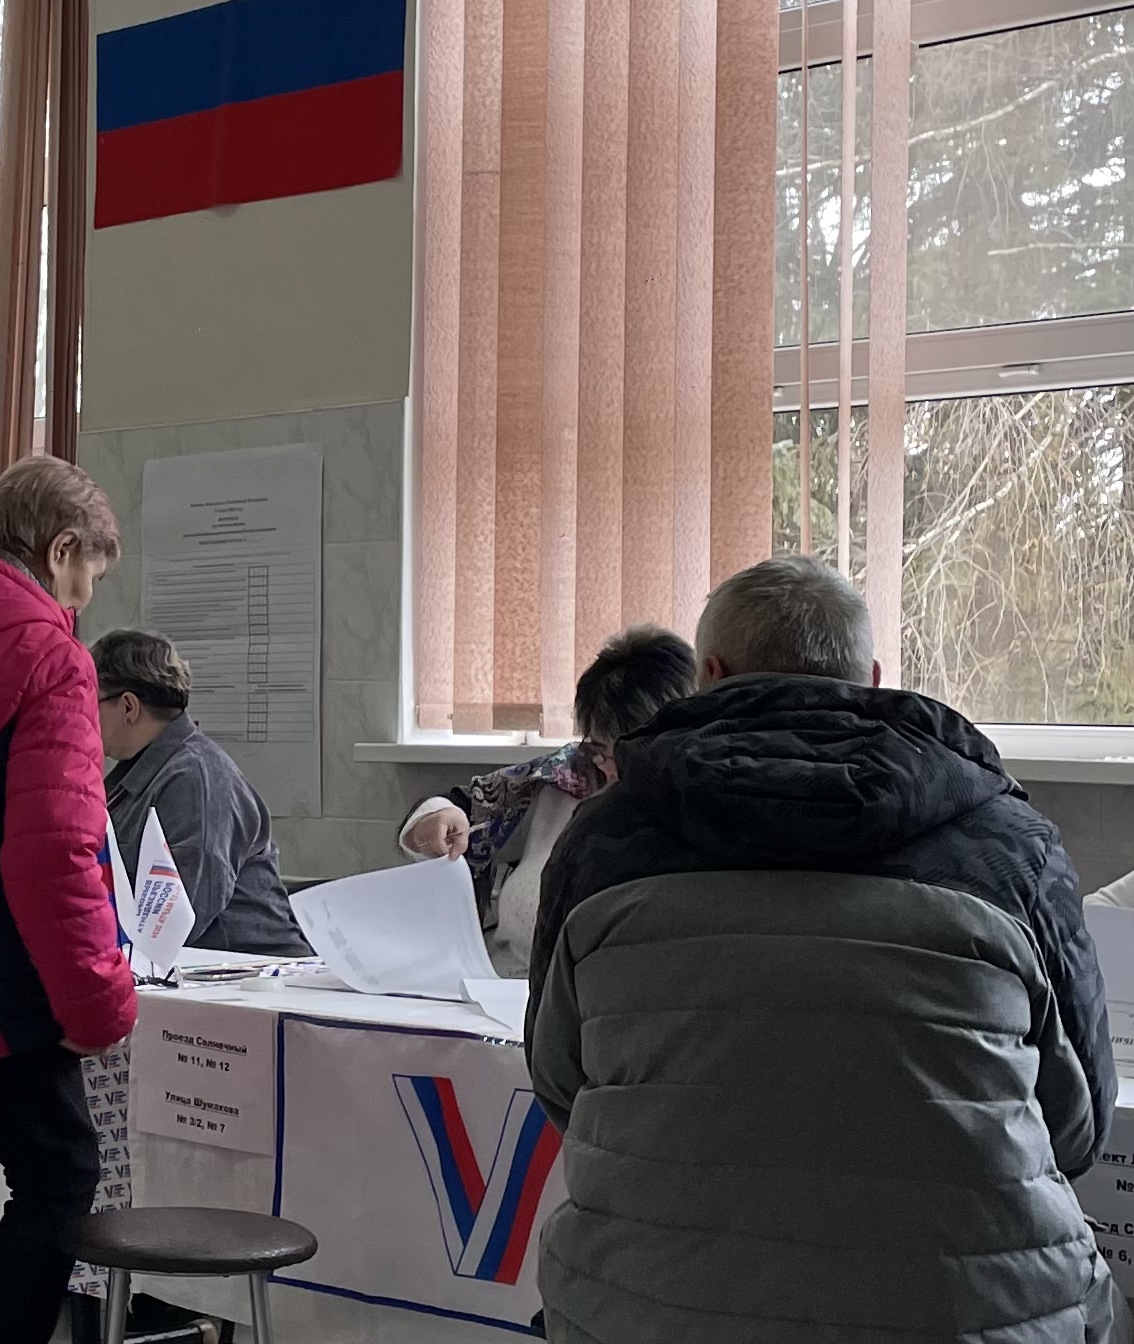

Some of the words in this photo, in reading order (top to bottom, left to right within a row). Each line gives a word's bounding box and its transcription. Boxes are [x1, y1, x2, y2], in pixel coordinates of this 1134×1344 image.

[162, 1029, 194, 1046] Проезд
[196, 1036, 248, 1055] Солнечный
[177, 1052, 187, 1063] №
[191, 1055, 203, 1068] 11,
[206, 1058, 216, 1069] №
[219, 1061, 230, 1072] 12
[165, 1091, 191, 1105] Улица
[176, 1114, 187, 1124] №
[207, 1120, 217, 1131] №
[220, 1123, 226, 1133] 7
